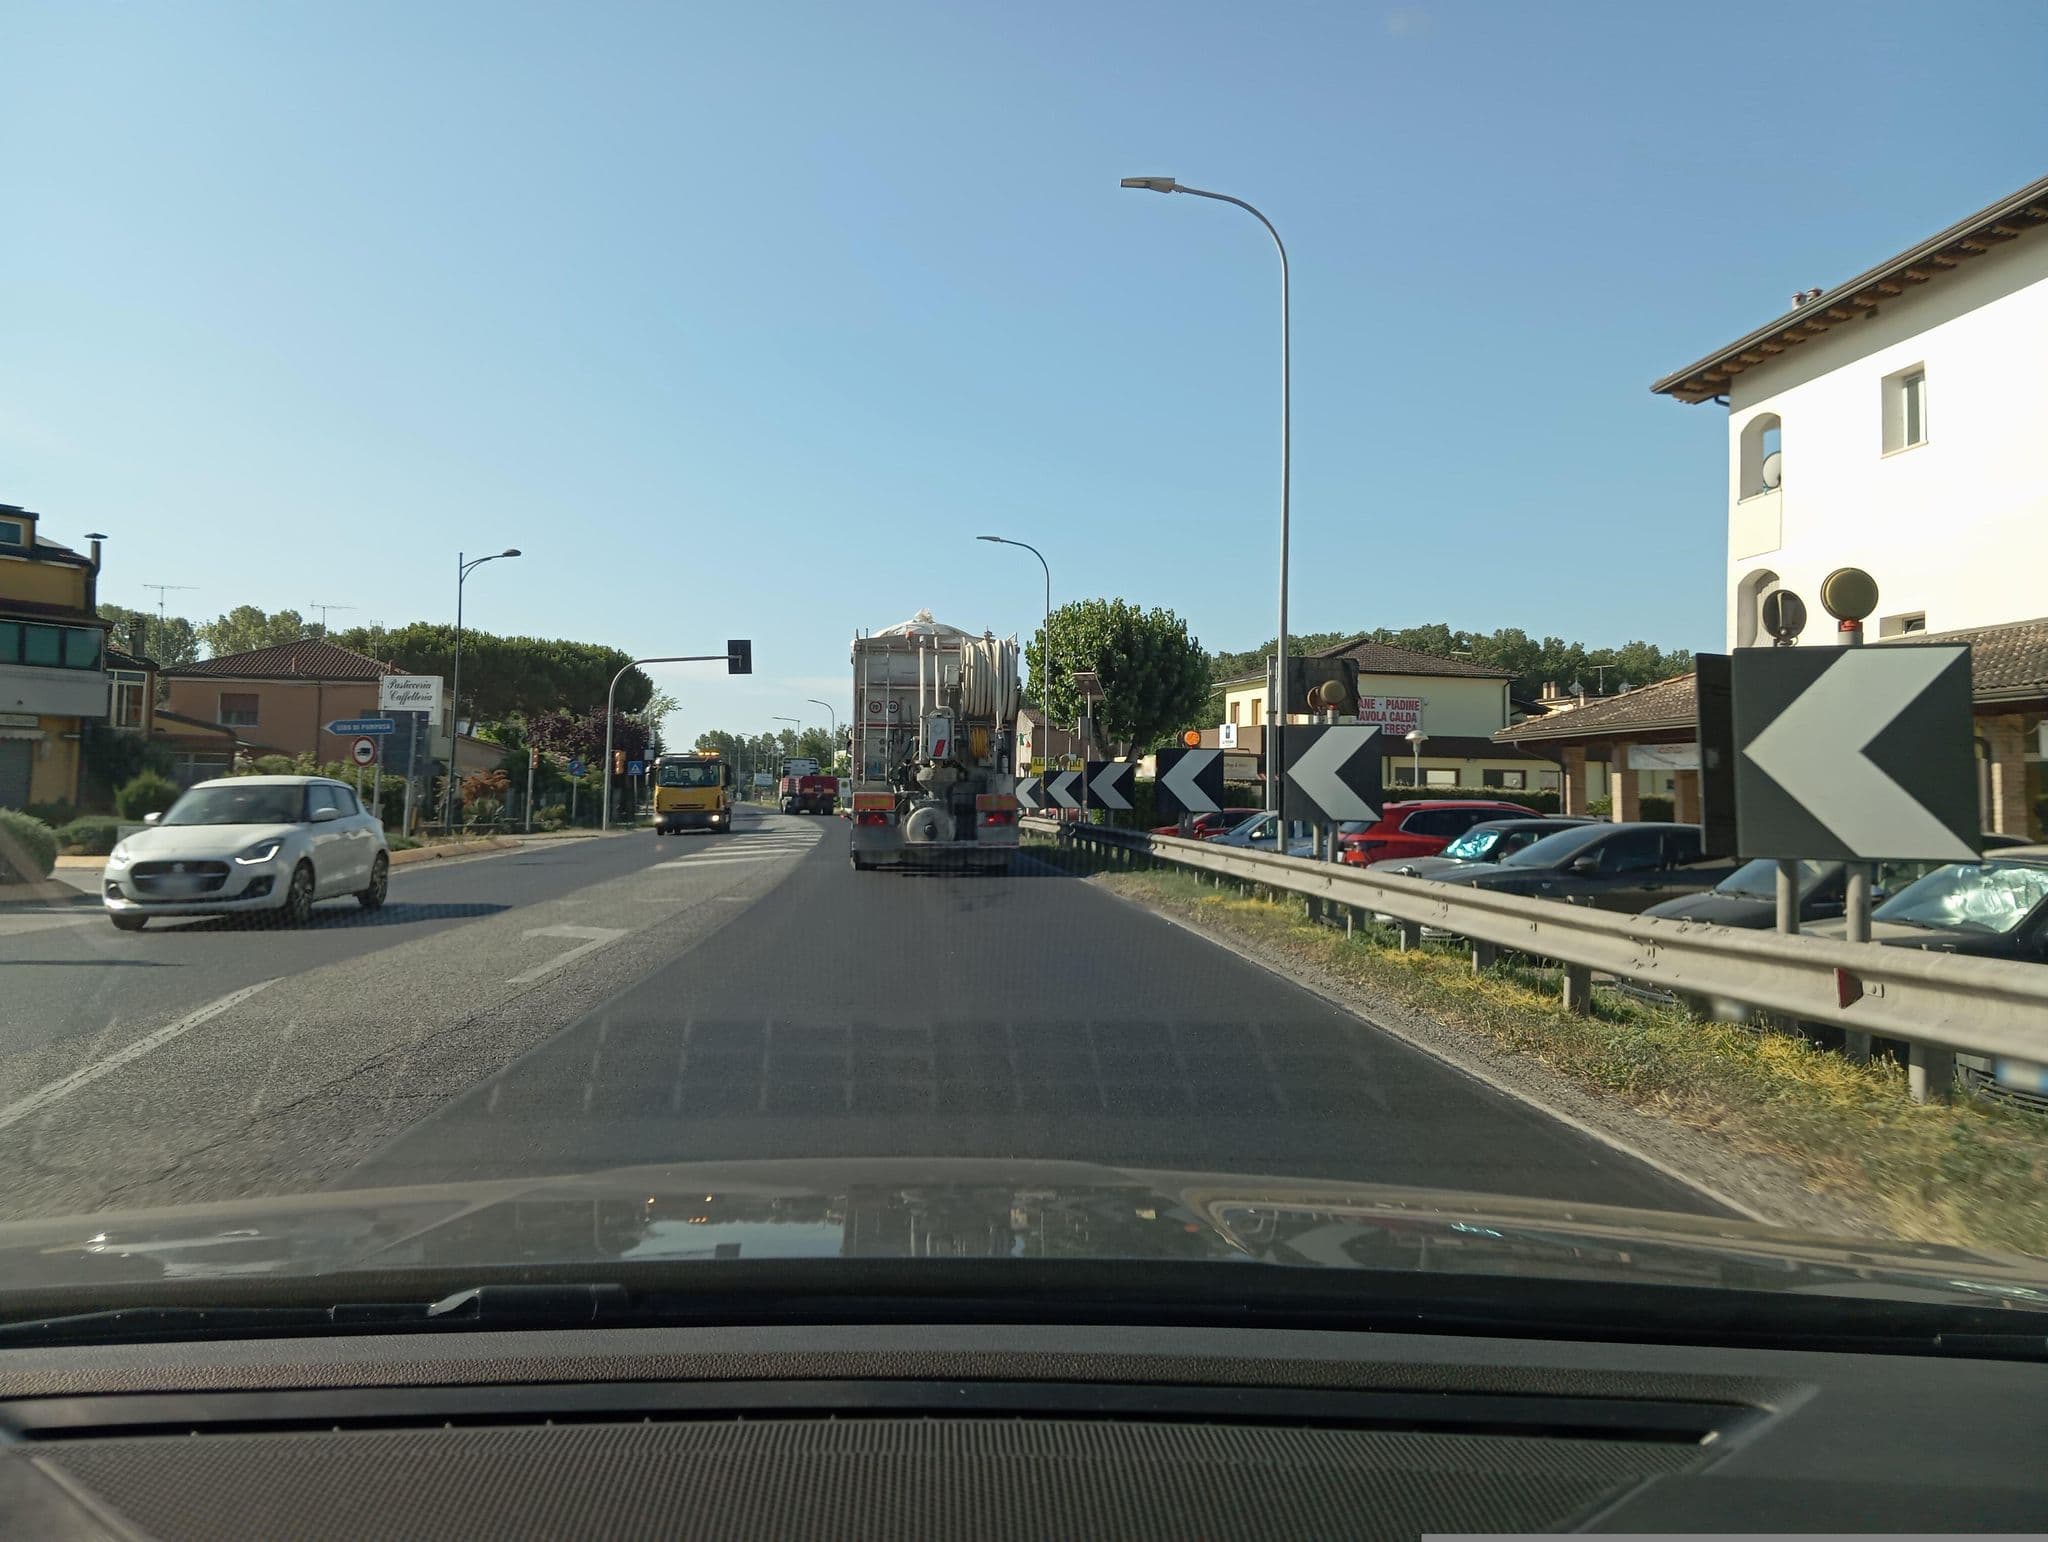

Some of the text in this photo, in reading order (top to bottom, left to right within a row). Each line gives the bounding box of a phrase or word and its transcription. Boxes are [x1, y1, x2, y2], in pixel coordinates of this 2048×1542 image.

[387, 679, 432, 689] Pasticceria
[390, 690, 433, 705] Caffetteria
[1360, 699, 1376, 709] ANE
[1386, 699, 1420, 711] PIADINE
[1359, 711, 1417, 723] AVOLA CALDA
